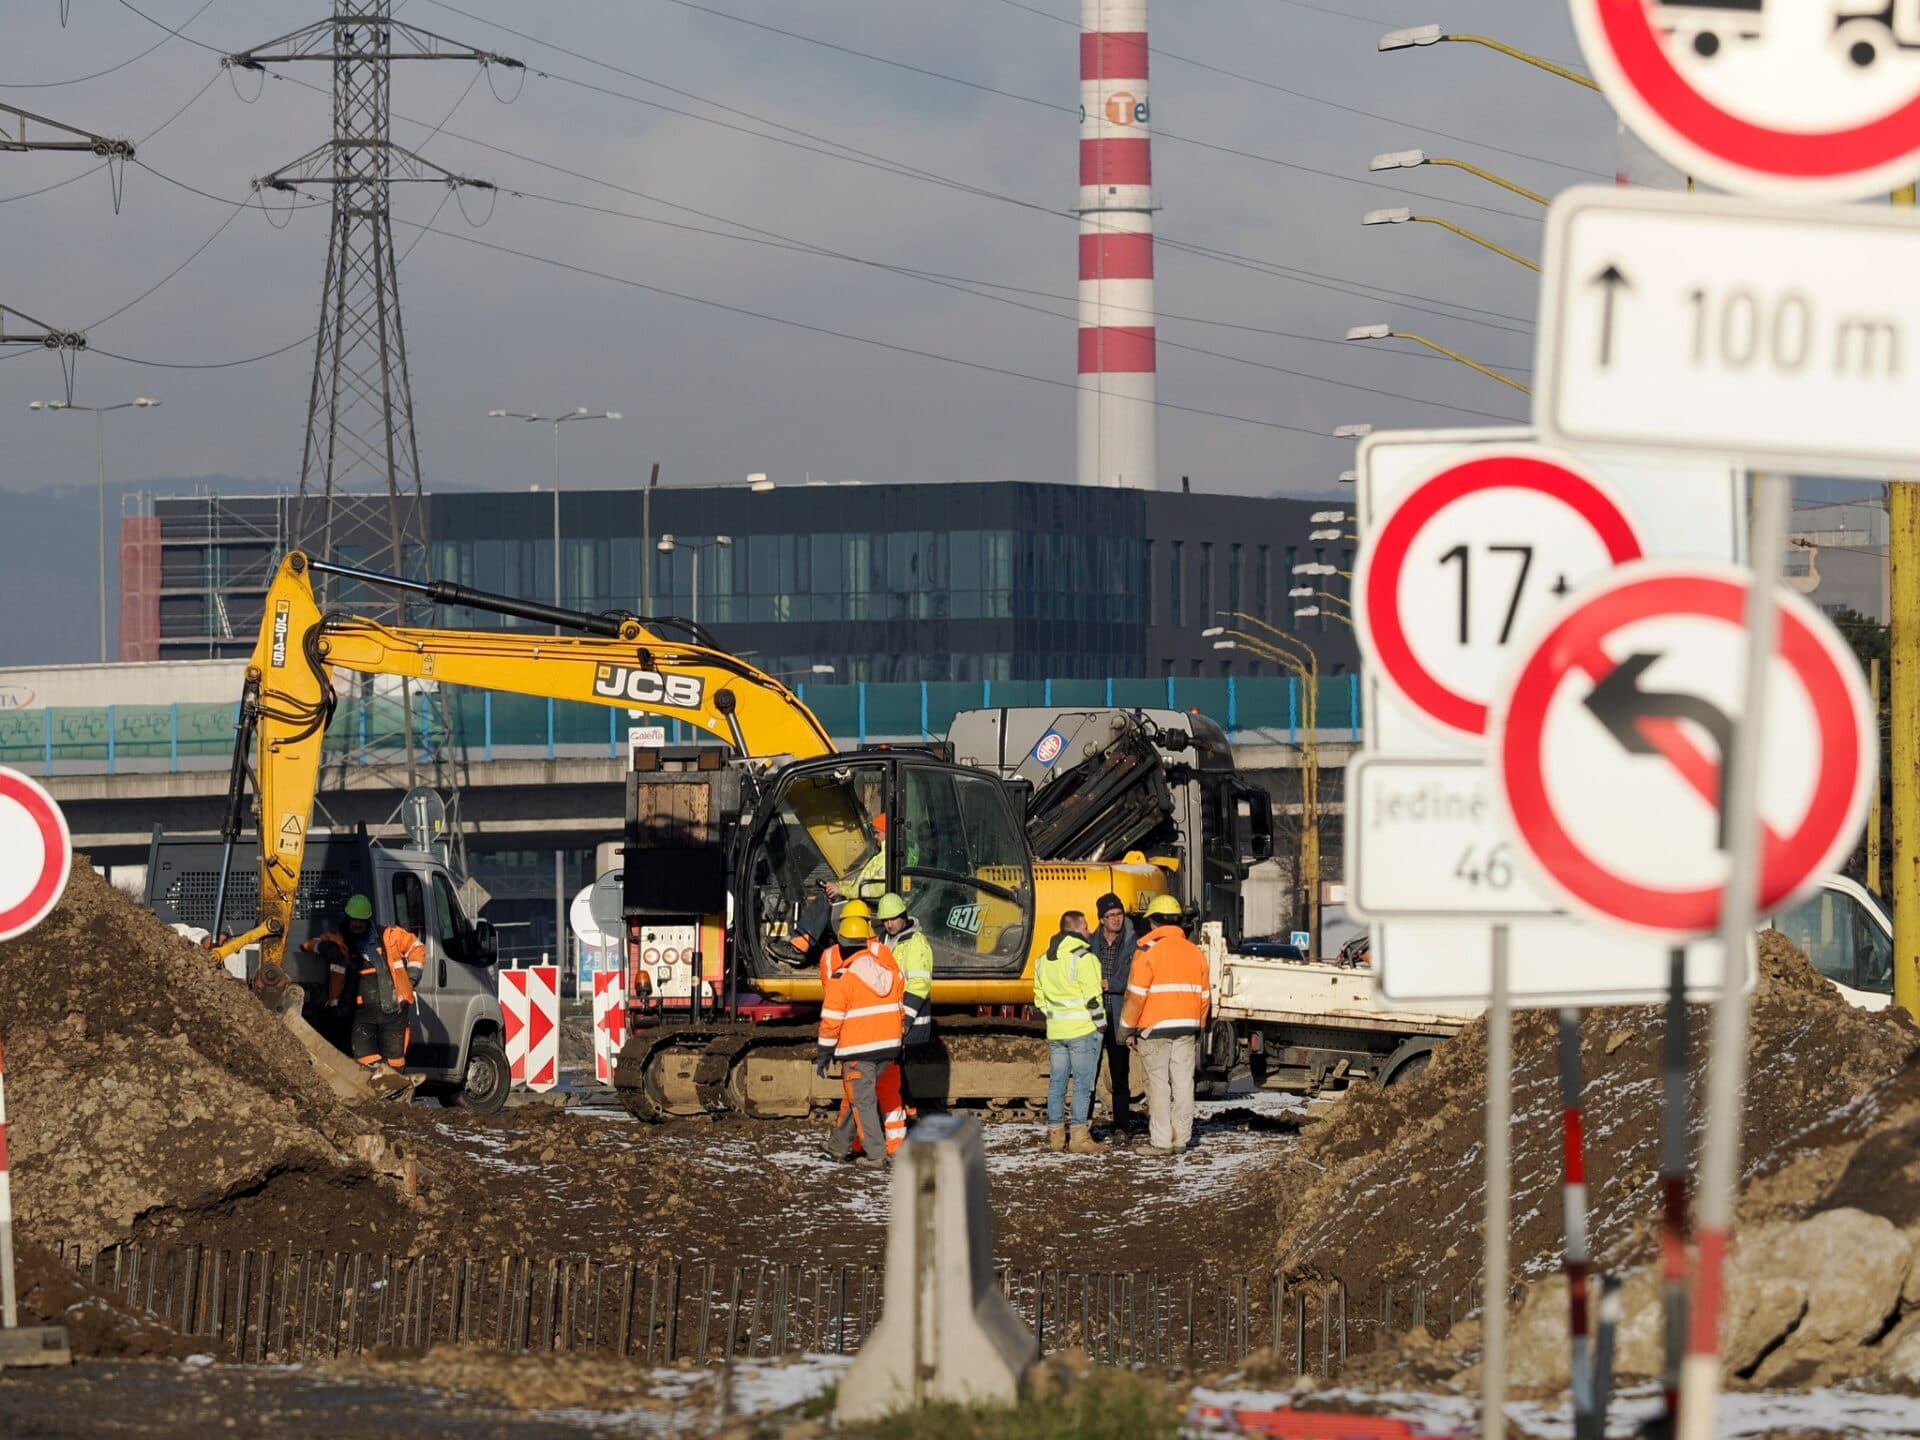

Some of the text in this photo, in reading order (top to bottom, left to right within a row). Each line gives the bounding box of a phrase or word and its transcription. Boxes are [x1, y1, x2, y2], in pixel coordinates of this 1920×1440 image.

[1687, 287, 1903, 379] 100 m
[1438, 544, 1533, 645] 17
[596, 667, 701, 706] JCB
[1453, 842, 1513, 888] 46
